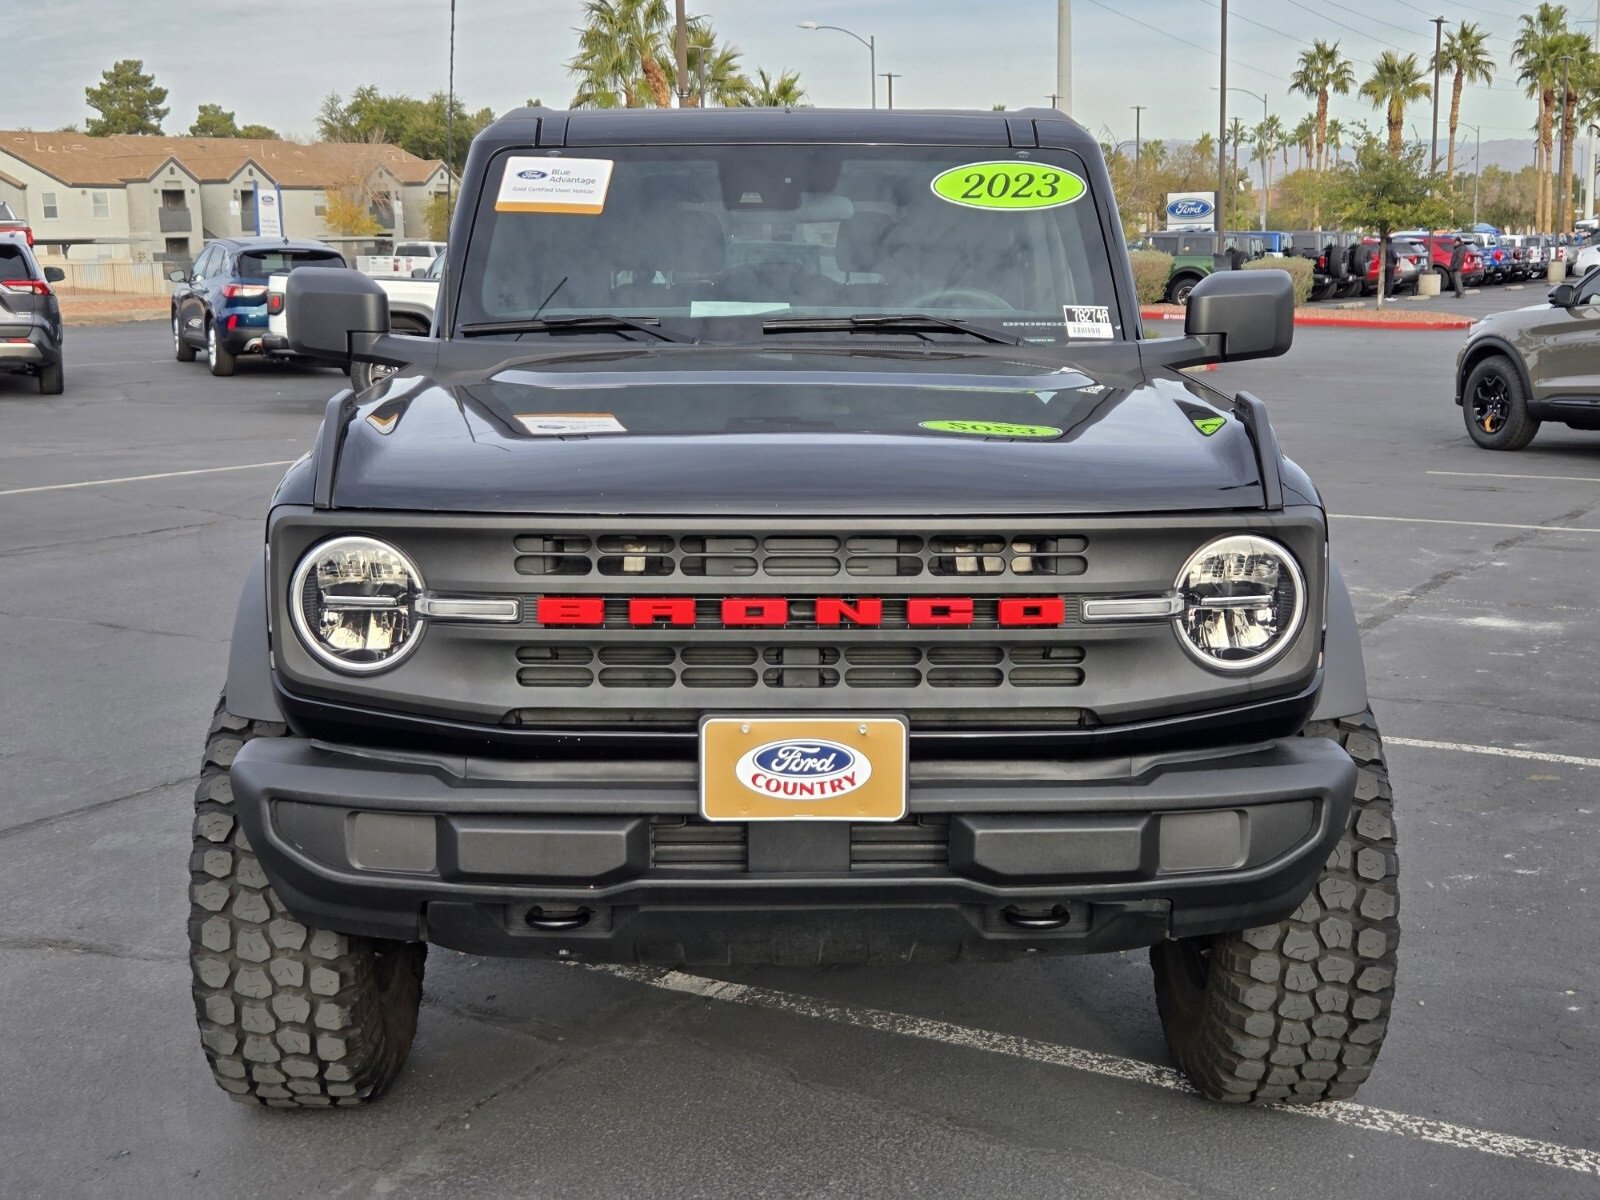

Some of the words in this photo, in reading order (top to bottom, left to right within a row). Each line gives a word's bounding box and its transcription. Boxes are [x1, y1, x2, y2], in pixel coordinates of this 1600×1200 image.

[522, 170, 543, 180] Ford
[549, 176, 597, 185] Advantage
[551, 168, 571, 176] Blue
[960, 172, 1061, 199] 2023
[1175, 201, 1203, 214] Ford
[537, 596, 1066, 625] BRONCO
[771, 746, 836, 772] Ford
[751, 771, 858, 796] COUNTRY
